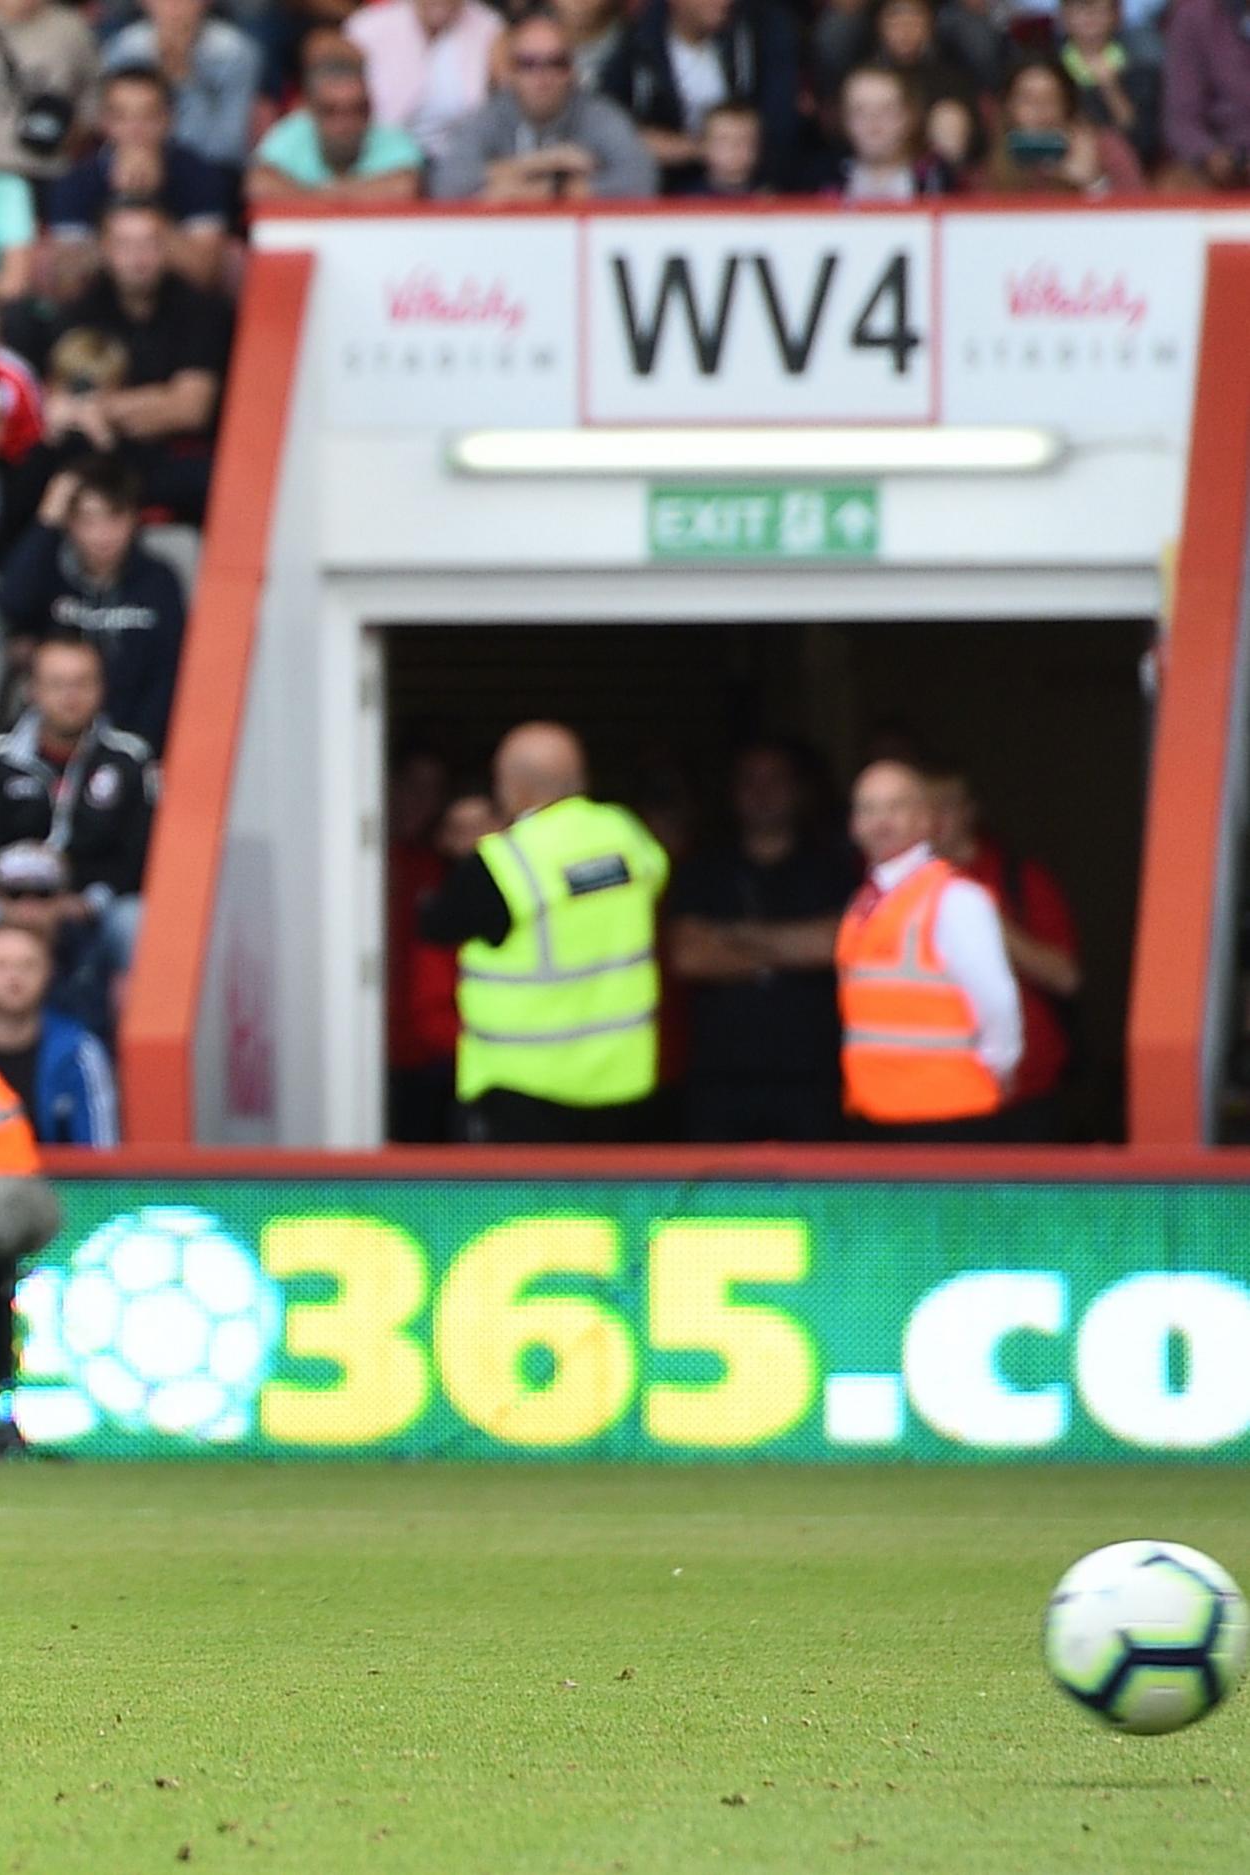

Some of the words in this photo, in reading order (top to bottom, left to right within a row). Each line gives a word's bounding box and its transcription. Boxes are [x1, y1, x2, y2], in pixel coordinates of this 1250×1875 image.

[612, 254, 922, 375] WV4
[1008, 258, 1147, 332] Vitality
[655, 498, 771, 544] EXIT
